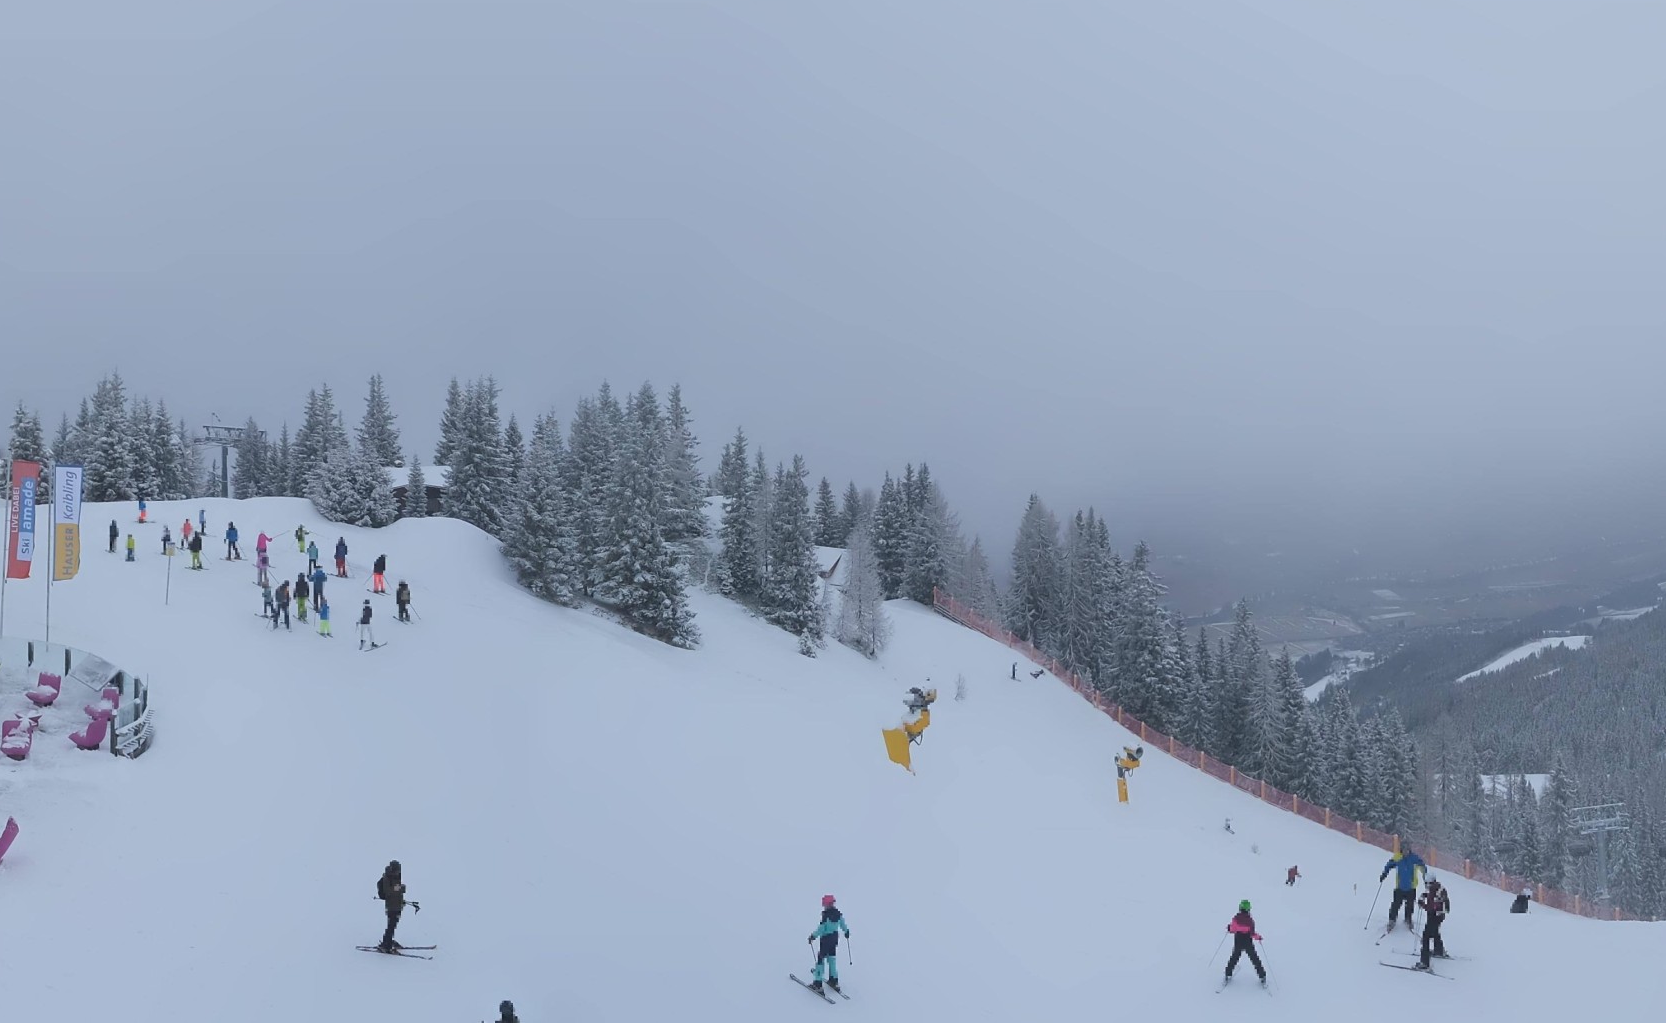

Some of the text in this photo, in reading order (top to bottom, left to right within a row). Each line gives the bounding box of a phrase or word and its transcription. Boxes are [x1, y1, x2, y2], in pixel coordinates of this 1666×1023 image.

[22, 480, 34, 554] Ski amade
[62, 471, 77, 575] HAUSER Kaibling
